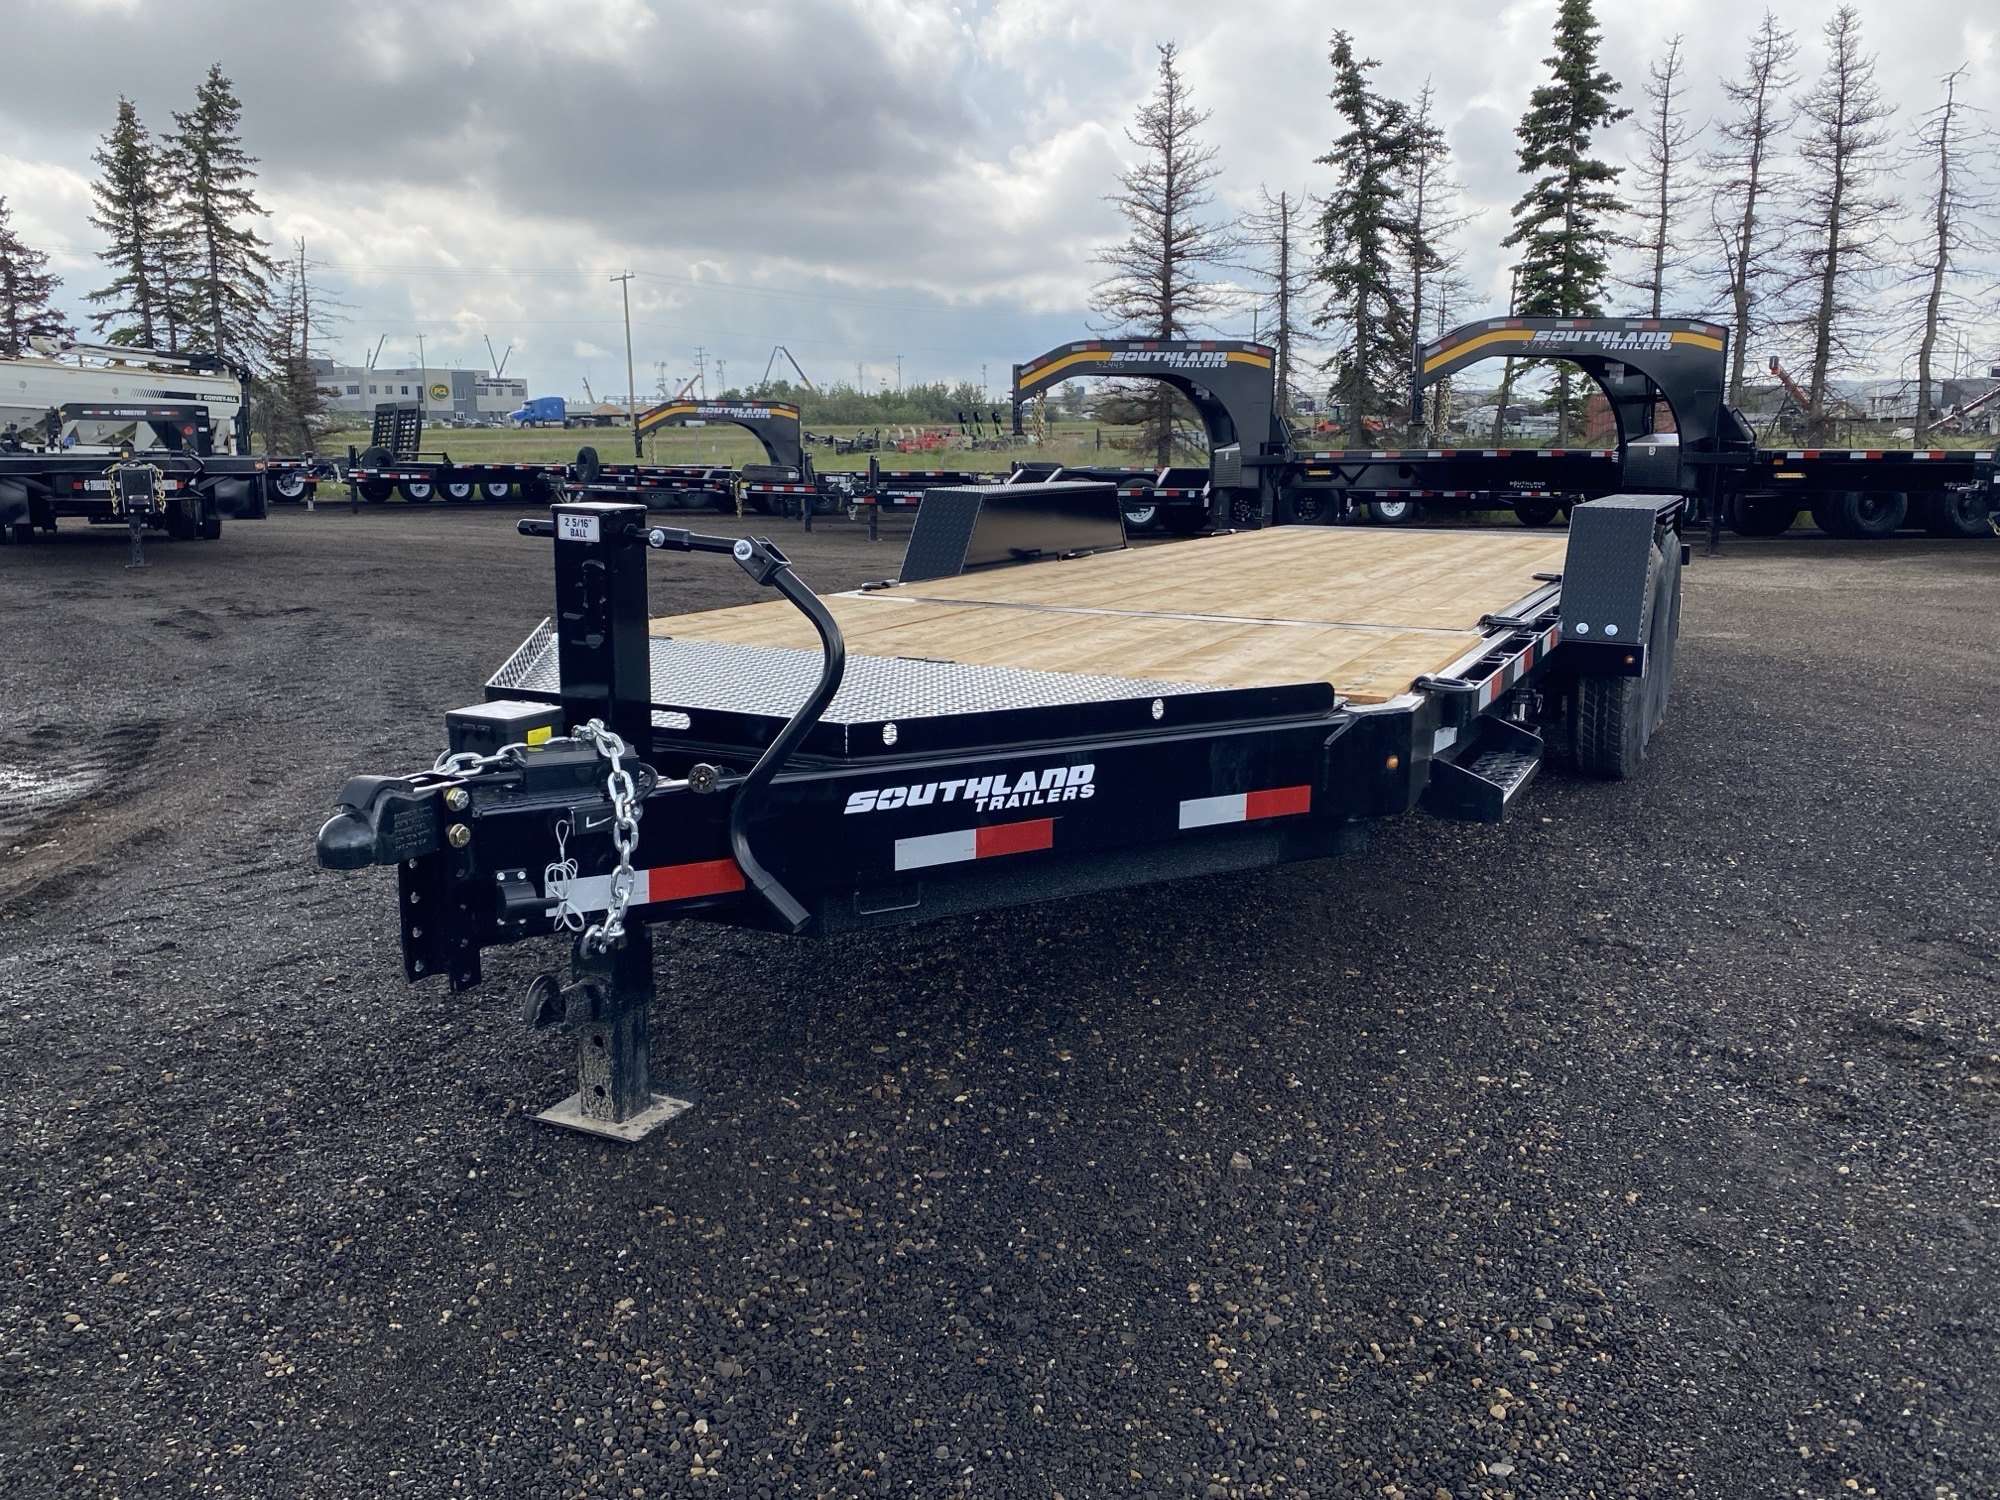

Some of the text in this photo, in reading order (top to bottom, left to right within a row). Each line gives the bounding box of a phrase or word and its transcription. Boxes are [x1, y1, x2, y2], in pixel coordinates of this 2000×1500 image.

[1534, 330, 1672, 342] SOUTHLAND
[1601, 342, 1672, 350] TRAILERS
[1111, 351, 1227, 362] SOUTHLAND
[696, 407, 770, 416] SOUTHLAND
[564, 517, 570, 527] 2
[570, 528, 587, 538] BALL
[843, 763, 1096, 815] SOUTHLAND
[974, 784, 1096, 812] TRAILERS
